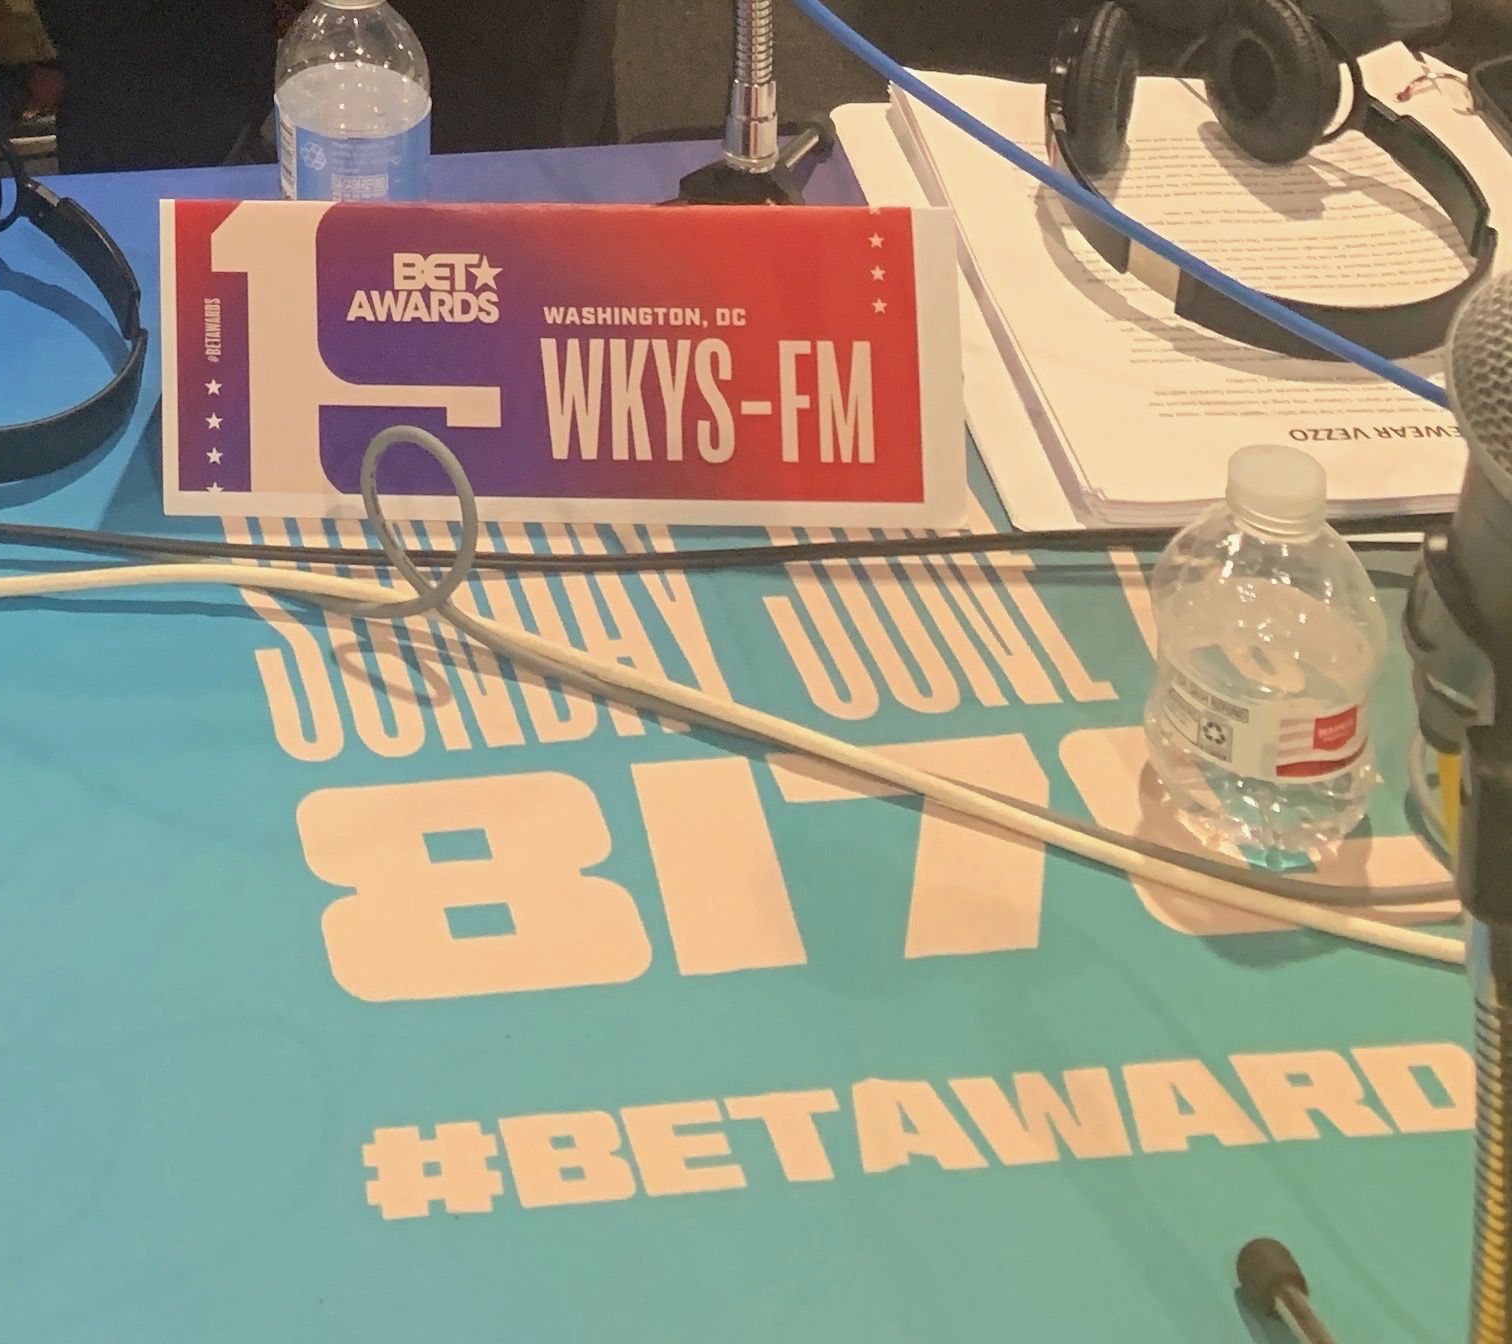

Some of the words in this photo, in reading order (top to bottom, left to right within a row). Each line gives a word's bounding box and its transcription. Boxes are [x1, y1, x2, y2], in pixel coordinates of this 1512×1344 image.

[393, 253, 478, 291] BET
[346, 291, 500, 324] AWARDS
[544, 307, 707, 330] WASHINGTON,
[716, 308, 746, 326] DC
[204, 298, 221, 363] #BETAWARDS
[541, 338, 875, 464] WKYS-FM
[1289, 425, 1371, 441] VEZZO
[1373, 424, 1463, 440] EWEAR
[362, 1042, 1477, 1220] #BETAWARD
